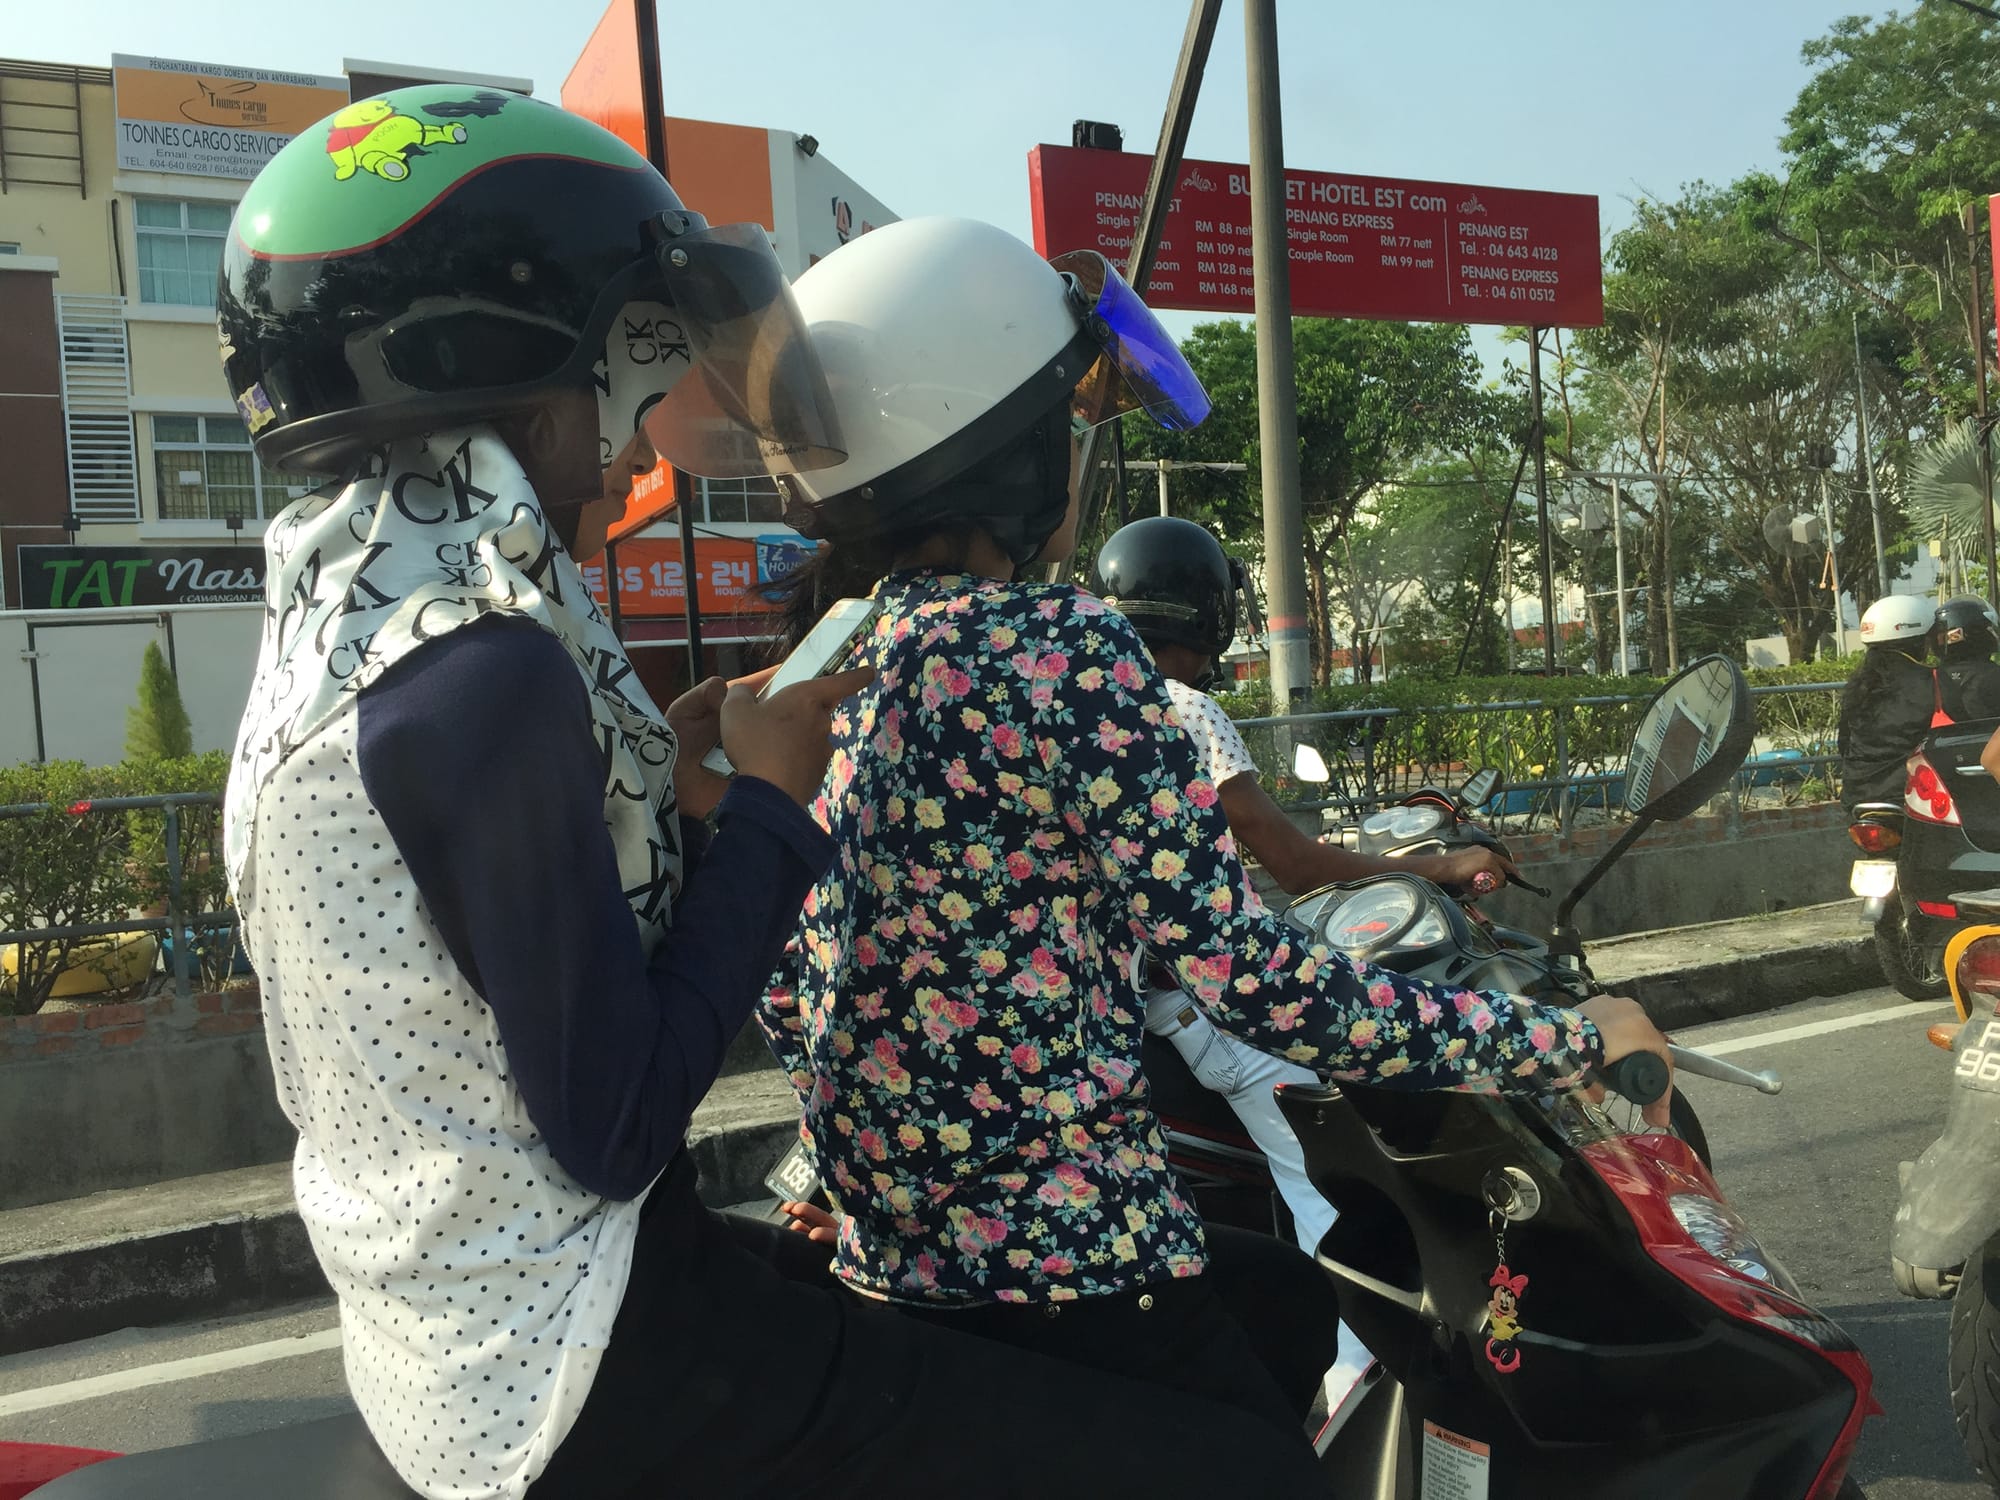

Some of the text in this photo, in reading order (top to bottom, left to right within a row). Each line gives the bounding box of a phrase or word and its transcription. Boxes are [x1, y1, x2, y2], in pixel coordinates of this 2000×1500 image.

[200, 66, 222, 76] KARGO
[224, 69, 254, 80] DOMESTIK
[256, 71, 269, 81] DAN
[271, 73, 318, 86] ANTARABANGSA
[122, 122, 180, 146] TONNES
[182, 128, 231, 151] CARGO
[1095, 192, 1144, 209] PENAN
[1311, 182, 1370, 207] HOTEL
[1374, 187, 1405, 208] EST
[1410, 195, 1447, 212] com
[1096, 212, 1131, 228] Single
[1195, 220, 1213, 233] RM
[1219, 222, 1232, 234] 88
[1285, 208, 1394, 230] PENANG EXPRESS
[1287, 229, 1349, 243] Single Room
[1459, 222, 1529, 240] PENANG EST
[1196, 241, 1214, 254] RM
[1217, 242, 1235, 255] 109
[1380, 235, 1433, 249] RM 77 nett
[1287, 248, 1354, 263] Couple Room
[1489, 243, 1504, 257] 04
[1507, 245, 1529, 259] 643
[1532, 247, 1558, 261] 4128
[1197, 261, 1216, 274] RM
[1218, 262, 1236, 275] 128
[1381, 255, 1435, 269] RM 99 nett
[1461, 265, 1559, 284] PENANG EXPRESS
[1199, 281, 1217, 294] RM
[1219, 282, 1238, 295] 168
[1491, 285, 1507, 299] 04
[1510, 287, 1526, 300] 611
[1529, 288, 1556, 302] 0512
[624, 316, 657, 365] CK
[655, 319, 690, 364] CK
[391, 437, 498, 524] CK
[649, 561, 684, 587] 12
[711, 560, 750, 586] 24
[42, 559, 153, 608] TAT
[327, 631, 384, 681] CK
[780, 1154, 815, 1194] 1096
